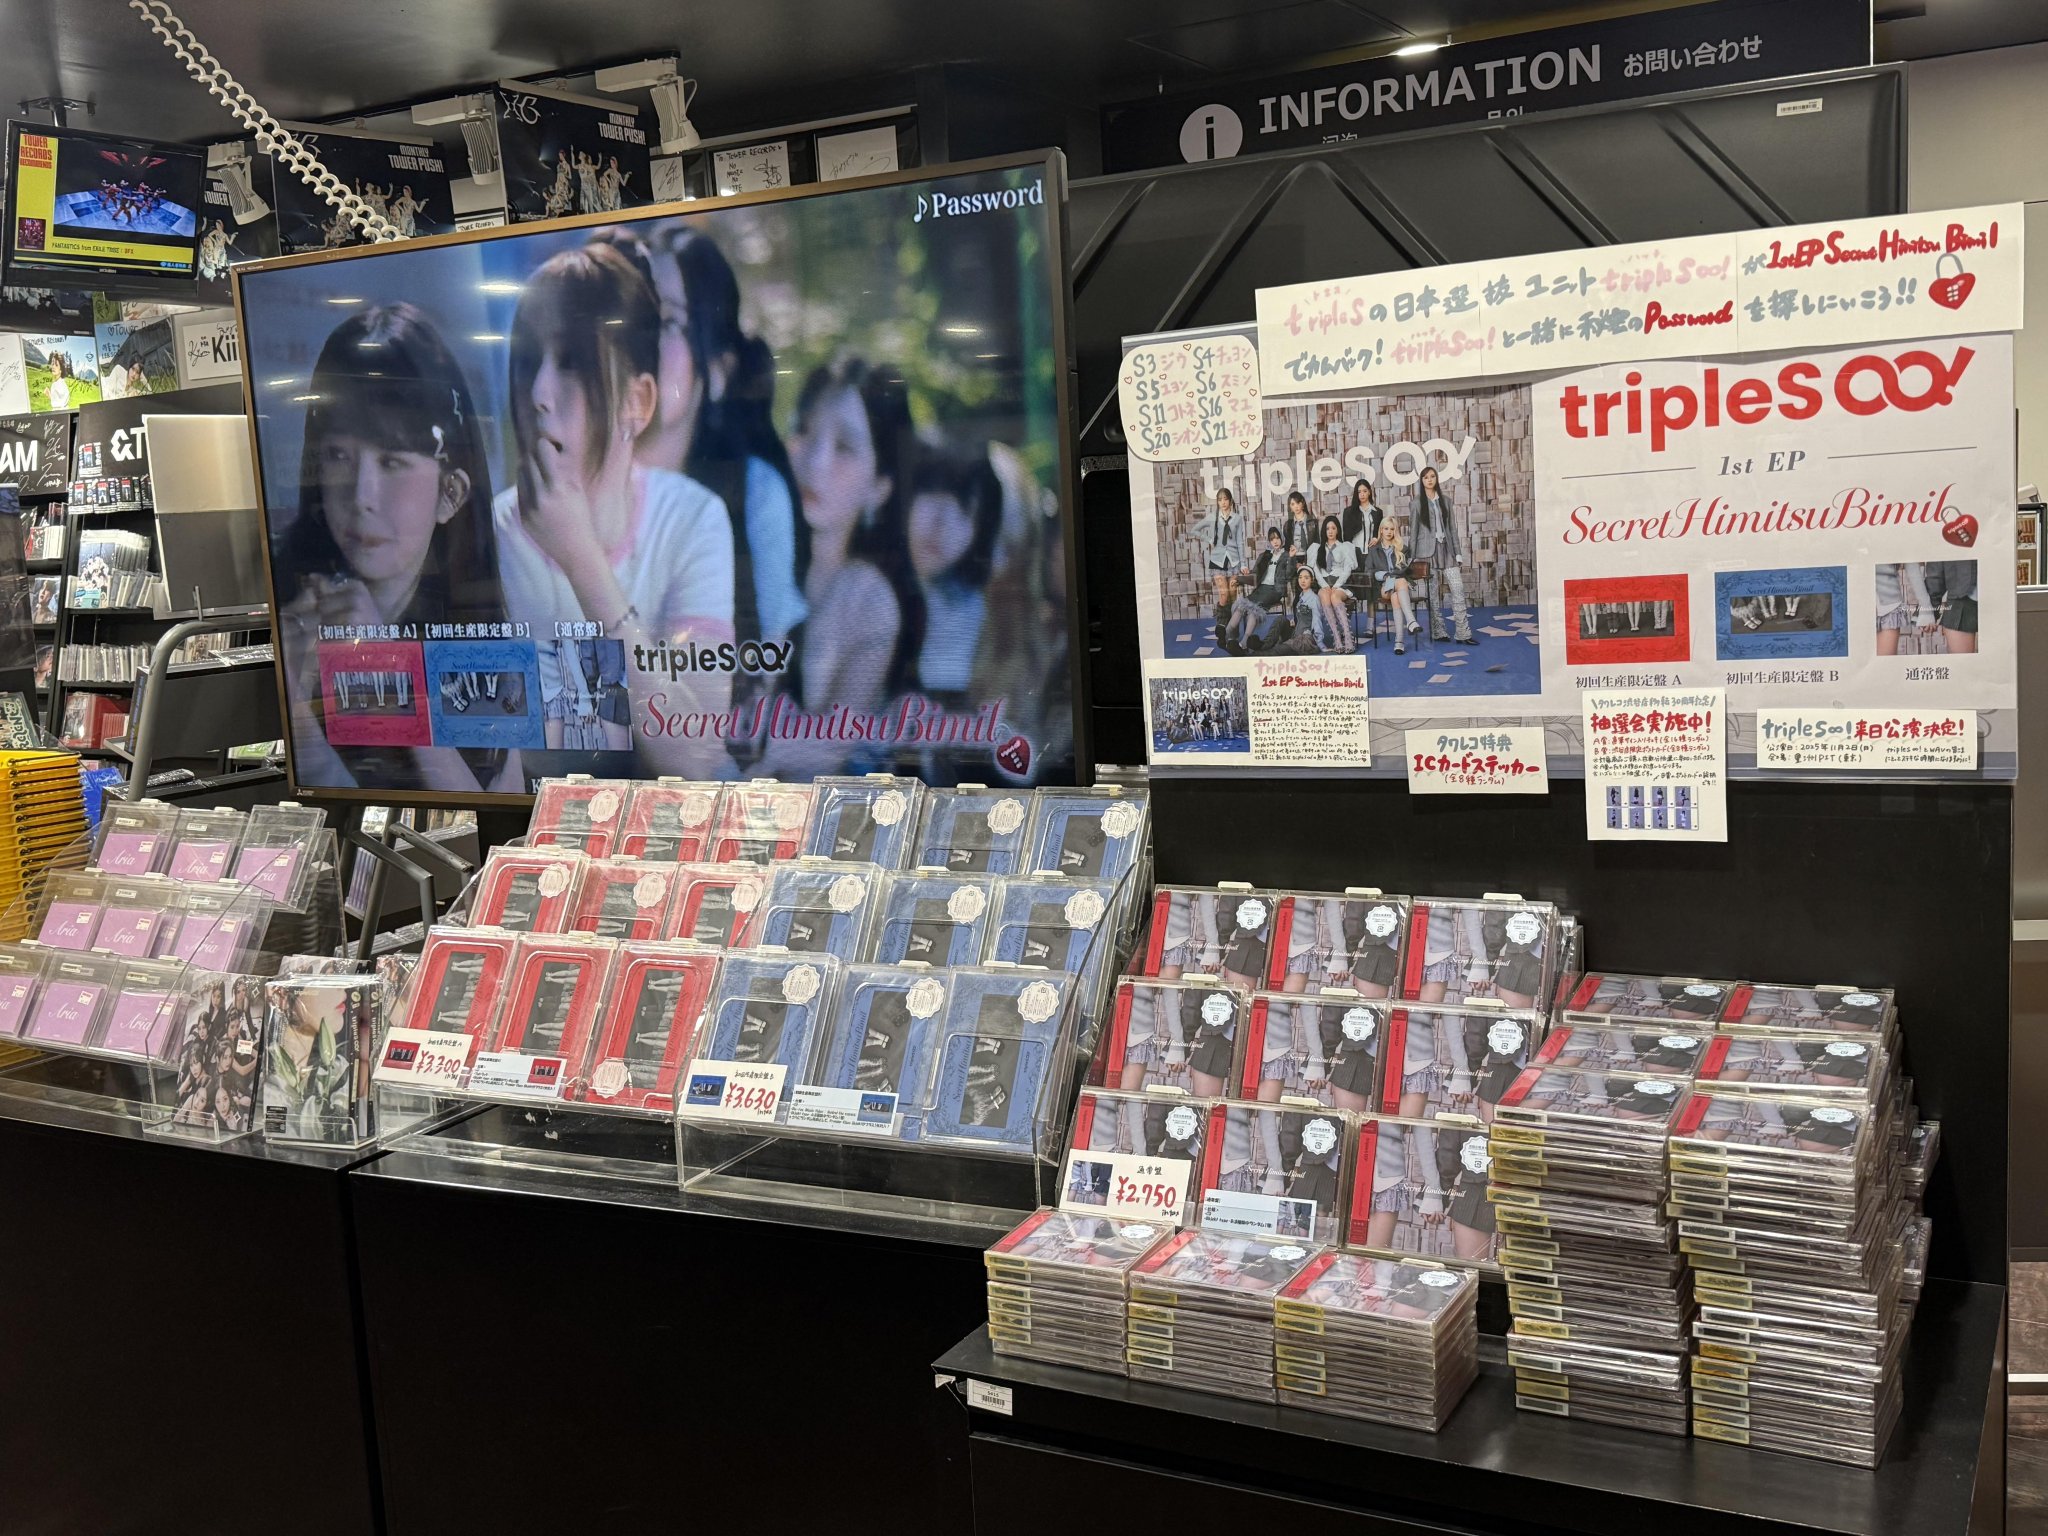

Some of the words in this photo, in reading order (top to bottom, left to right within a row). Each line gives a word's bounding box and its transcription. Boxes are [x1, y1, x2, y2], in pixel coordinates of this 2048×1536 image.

[1623, 36, 1763, 79] お問い合わせ
[1258, 45, 1602, 135] INFORMATION
[23, 134, 48, 148] TOWER
[598, 122, 624, 142] TOWER
[624, 128, 646, 146] PUSH!
[20, 145, 52, 161] RECORDS
[388, 154, 420, 171] TOWER
[420, 159, 444, 174] PUSH!
[932, 179, 1043, 217] Password
[1133, 354, 1156, 377] S3
[1193, 346, 1215, 370] S4
[1136, 379, 1160, 401] S5
[1196, 371, 1217, 394] S6
[1138, 403, 1167, 427] S11
[1198, 395, 1222, 420] S16
[1141, 427, 1171, 453] S20
[1201, 420, 1228, 446] S21
[1718, 454, 1754, 477] 1st
[1766, 450, 1807, 474] EP
[1576, 674, 1667, 688] 初回生産限定盤
[1672, 674, 1682, 685] A
[1726, 669, 1824, 685] 初回生産限定盤
[1829, 670, 1839, 682] B
[1905, 666, 1950, 681] 通常盤
[1590, 709, 1712, 734] 抽選会実施中!
[1437, 732, 1512, 752] タワレコ特典
[1413, 752, 1540, 776] ICカードステッカー
